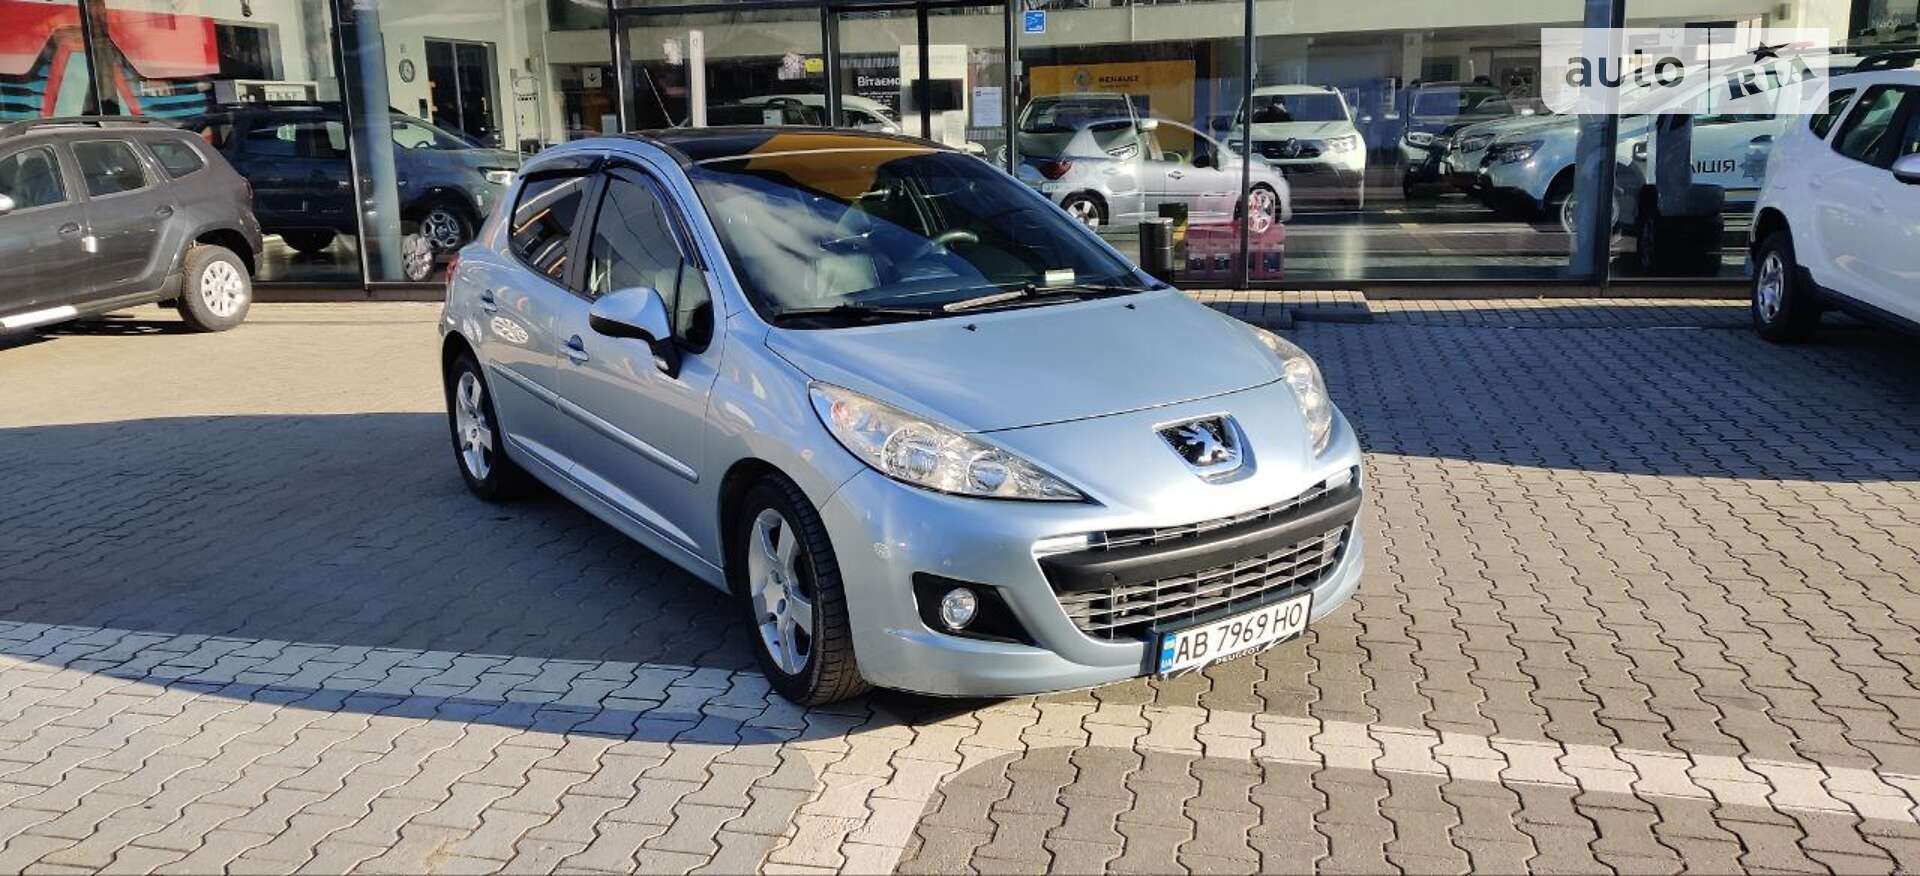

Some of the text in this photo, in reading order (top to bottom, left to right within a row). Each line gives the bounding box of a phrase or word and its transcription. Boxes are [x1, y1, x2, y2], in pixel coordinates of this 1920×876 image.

[1176, 603, 1303, 663] AB 7969 HO
[1161, 657, 1174, 670] UA
